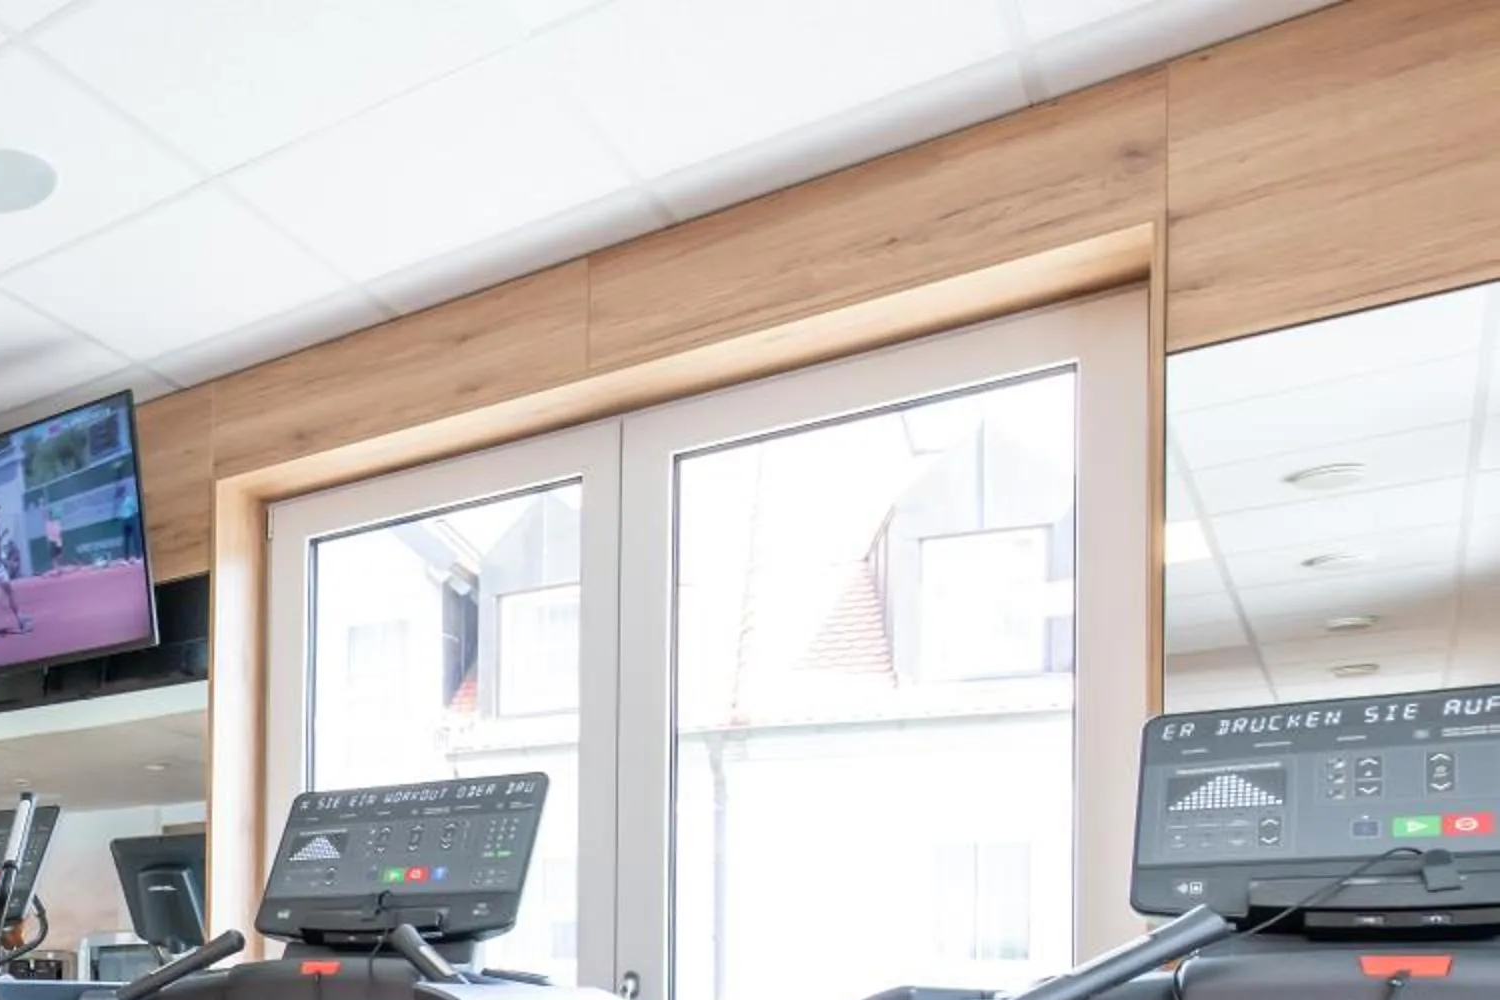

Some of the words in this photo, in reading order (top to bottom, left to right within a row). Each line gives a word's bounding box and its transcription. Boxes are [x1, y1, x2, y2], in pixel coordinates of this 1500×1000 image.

[1161, 722, 1196, 741] ER
[1215, 709, 1342, 736] DRUCKEN
[1364, 703, 1419, 724] SIE
[1443, 695, 1500, 717] AUF
[383, 788, 449, 803] WORKOUT
